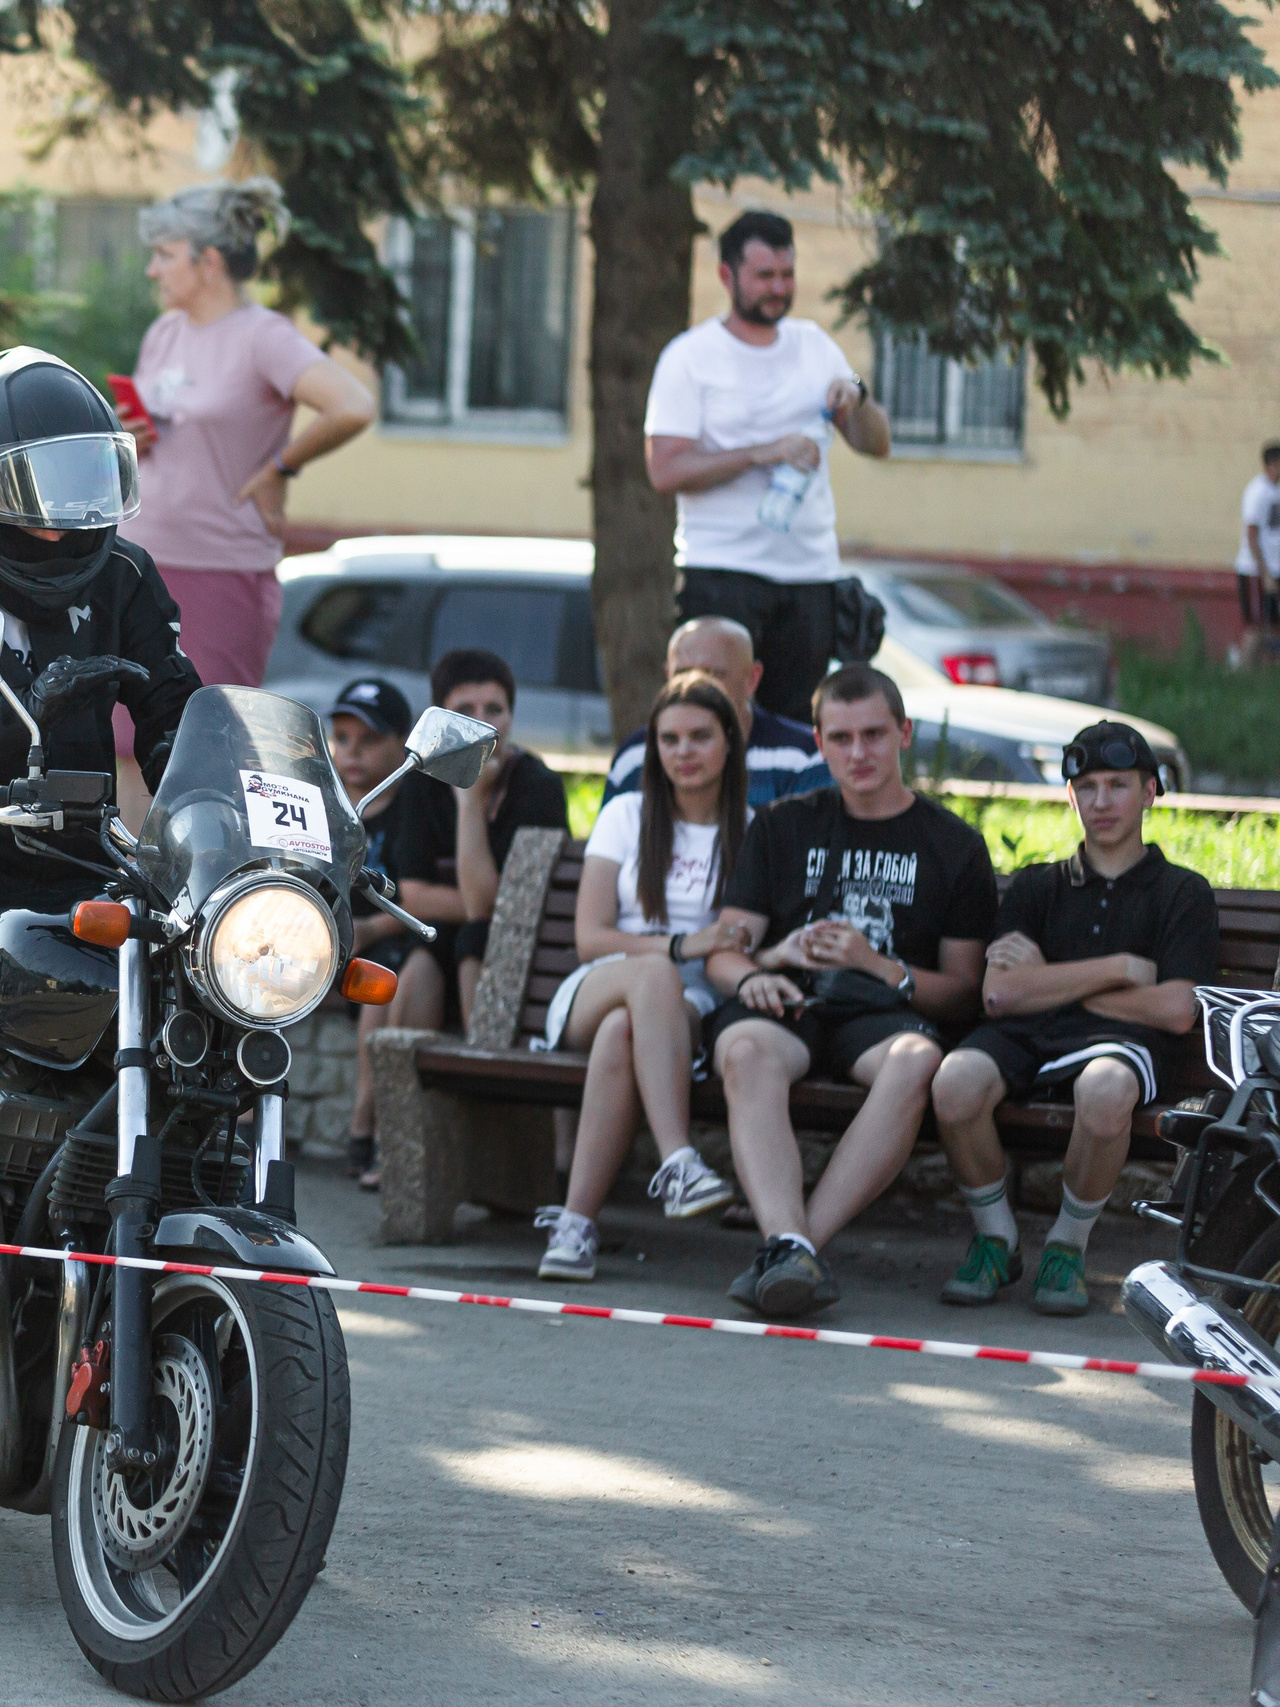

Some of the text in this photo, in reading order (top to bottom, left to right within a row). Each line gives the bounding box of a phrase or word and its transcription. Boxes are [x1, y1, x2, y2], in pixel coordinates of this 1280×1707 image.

[43, 496, 109, 511] LS2
[261, 786, 310, 803] GYMKHANA
[263, 782, 289, 792] MOTO
[272, 801, 308, 831] 24
[288, 840, 331, 852] AVTOSTOP
[853, 848, 871, 881] ЗА
[873, 850, 917, 886] СОБОЙ
